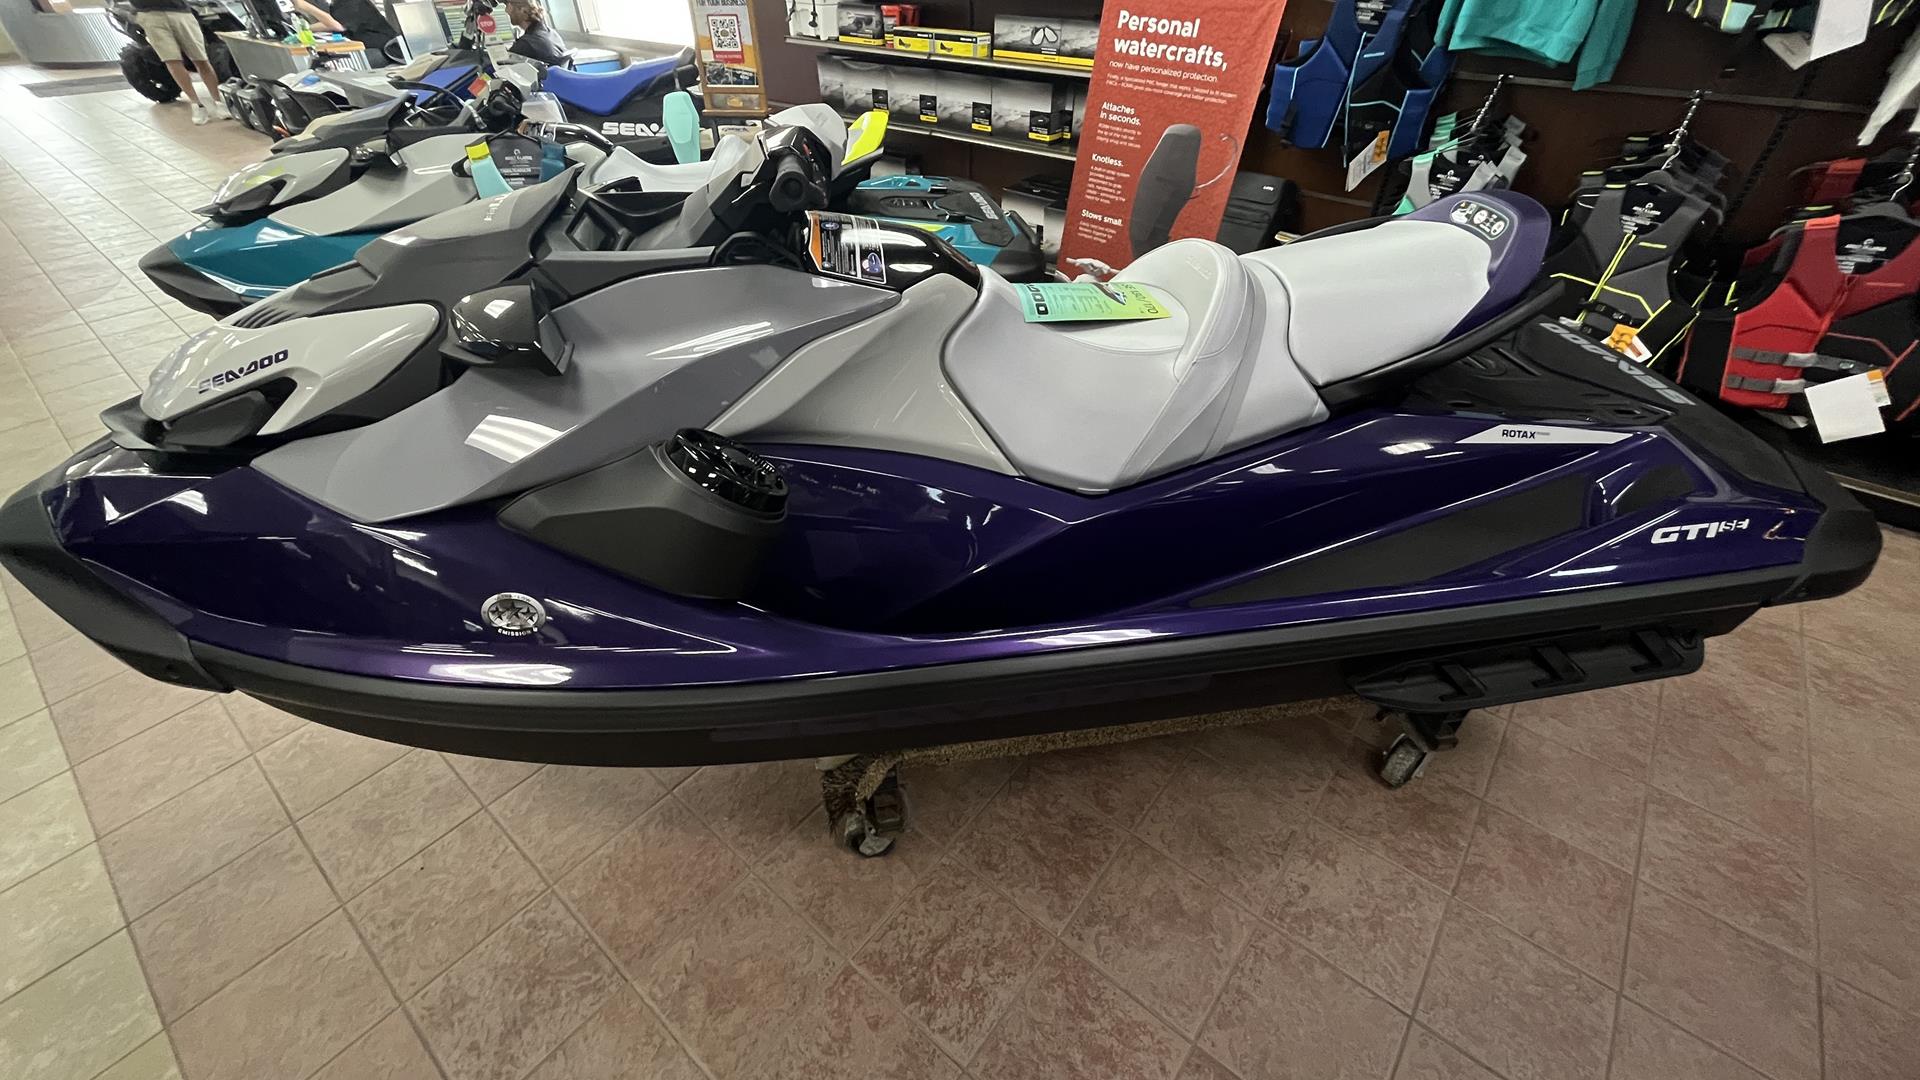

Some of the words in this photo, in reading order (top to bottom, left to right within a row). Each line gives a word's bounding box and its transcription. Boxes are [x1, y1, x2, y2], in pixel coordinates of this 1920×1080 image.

[1117, 9, 1200, 38] Personal
[1113, 37, 1228, 72] watercrafts,
[1109, 60, 1124, 69] now
[1124, 62, 1140, 72] have
[1140, 63, 1182, 79] personalized
[1182, 69, 1218, 83] protection
[1101, 101, 1135, 115] Attaches
[1108, 113, 1142, 126] seconds.
[1091, 153, 1124, 167] Knotless.
[1081, 209, 1103, 221] Stows
[1501, 429, 1537, 439] ROTAX
[1650, 521, 1720, 545] GTI
